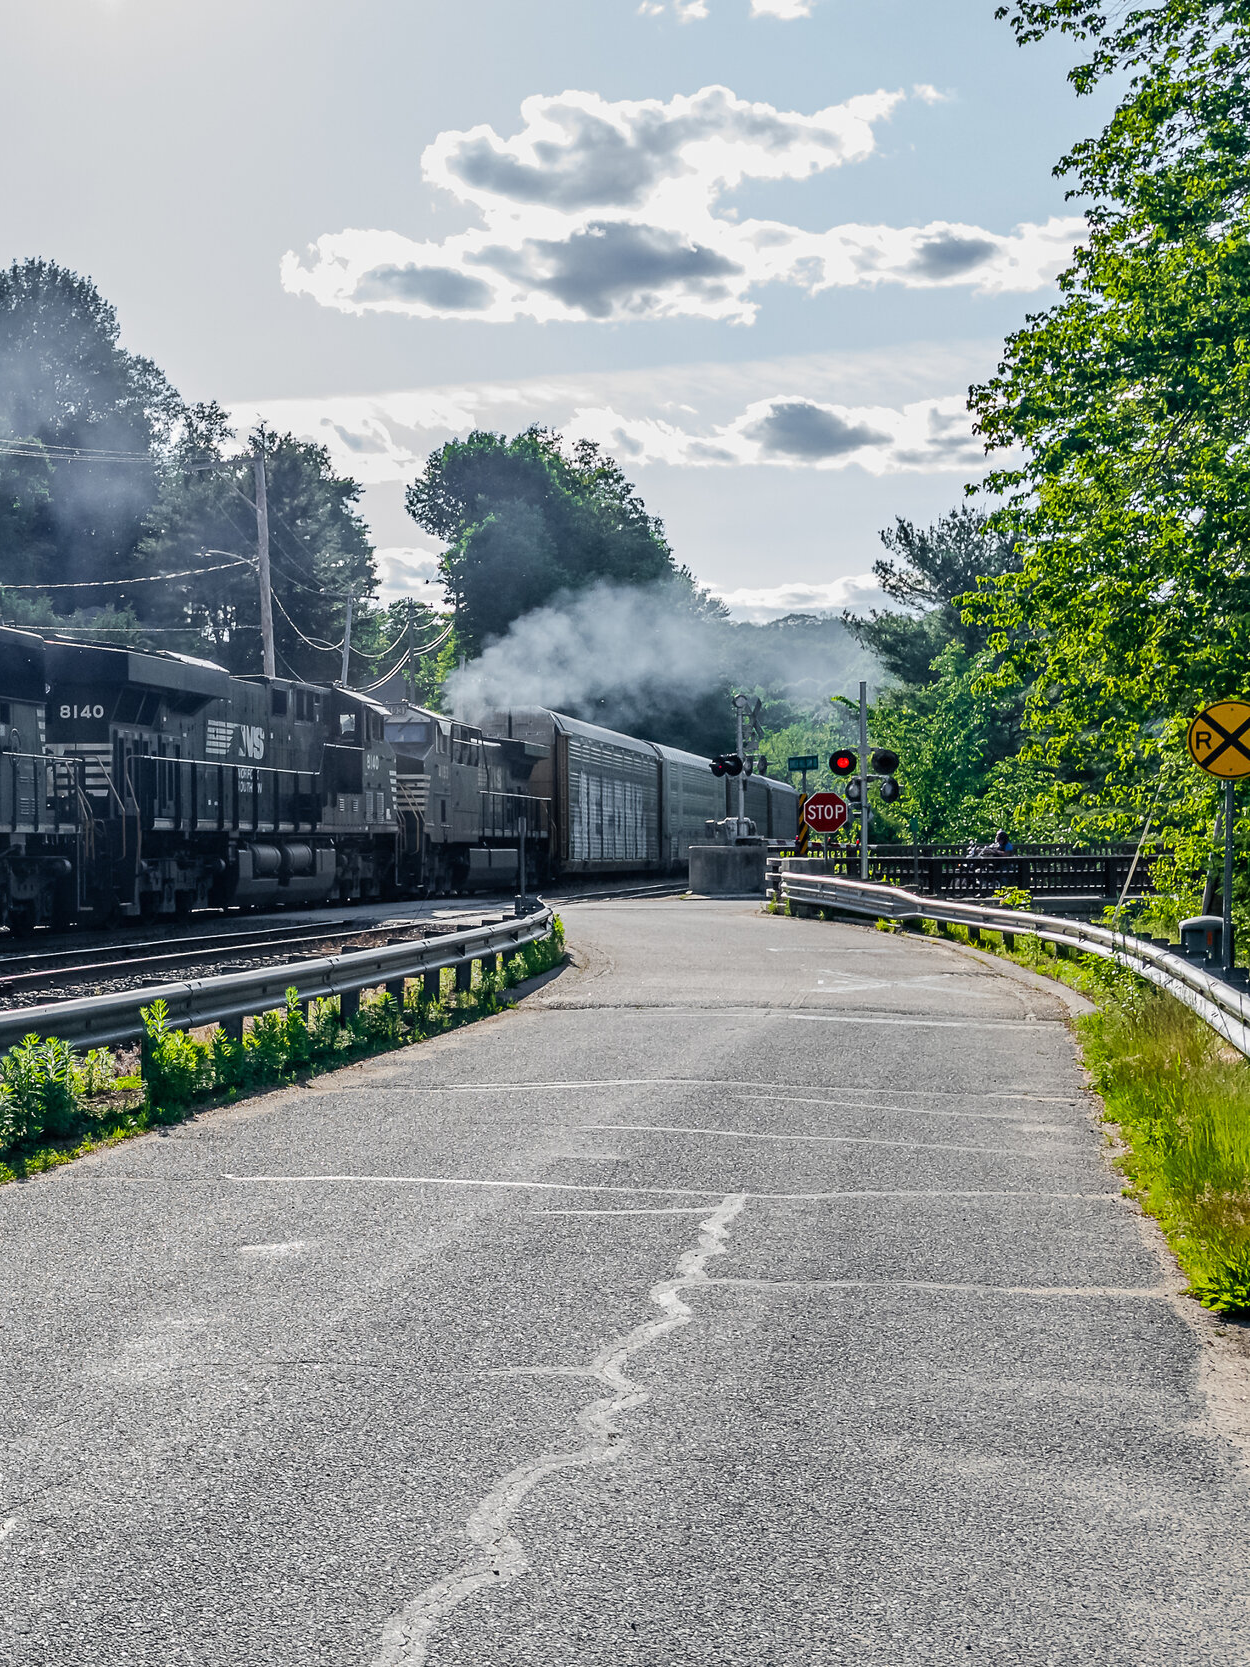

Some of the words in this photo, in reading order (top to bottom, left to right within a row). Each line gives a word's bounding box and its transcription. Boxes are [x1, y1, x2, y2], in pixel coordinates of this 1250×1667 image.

[59, 704, 104, 719] 8140
[1195, 731, 1212, 750] R
[807, 804, 844, 820] STOP
